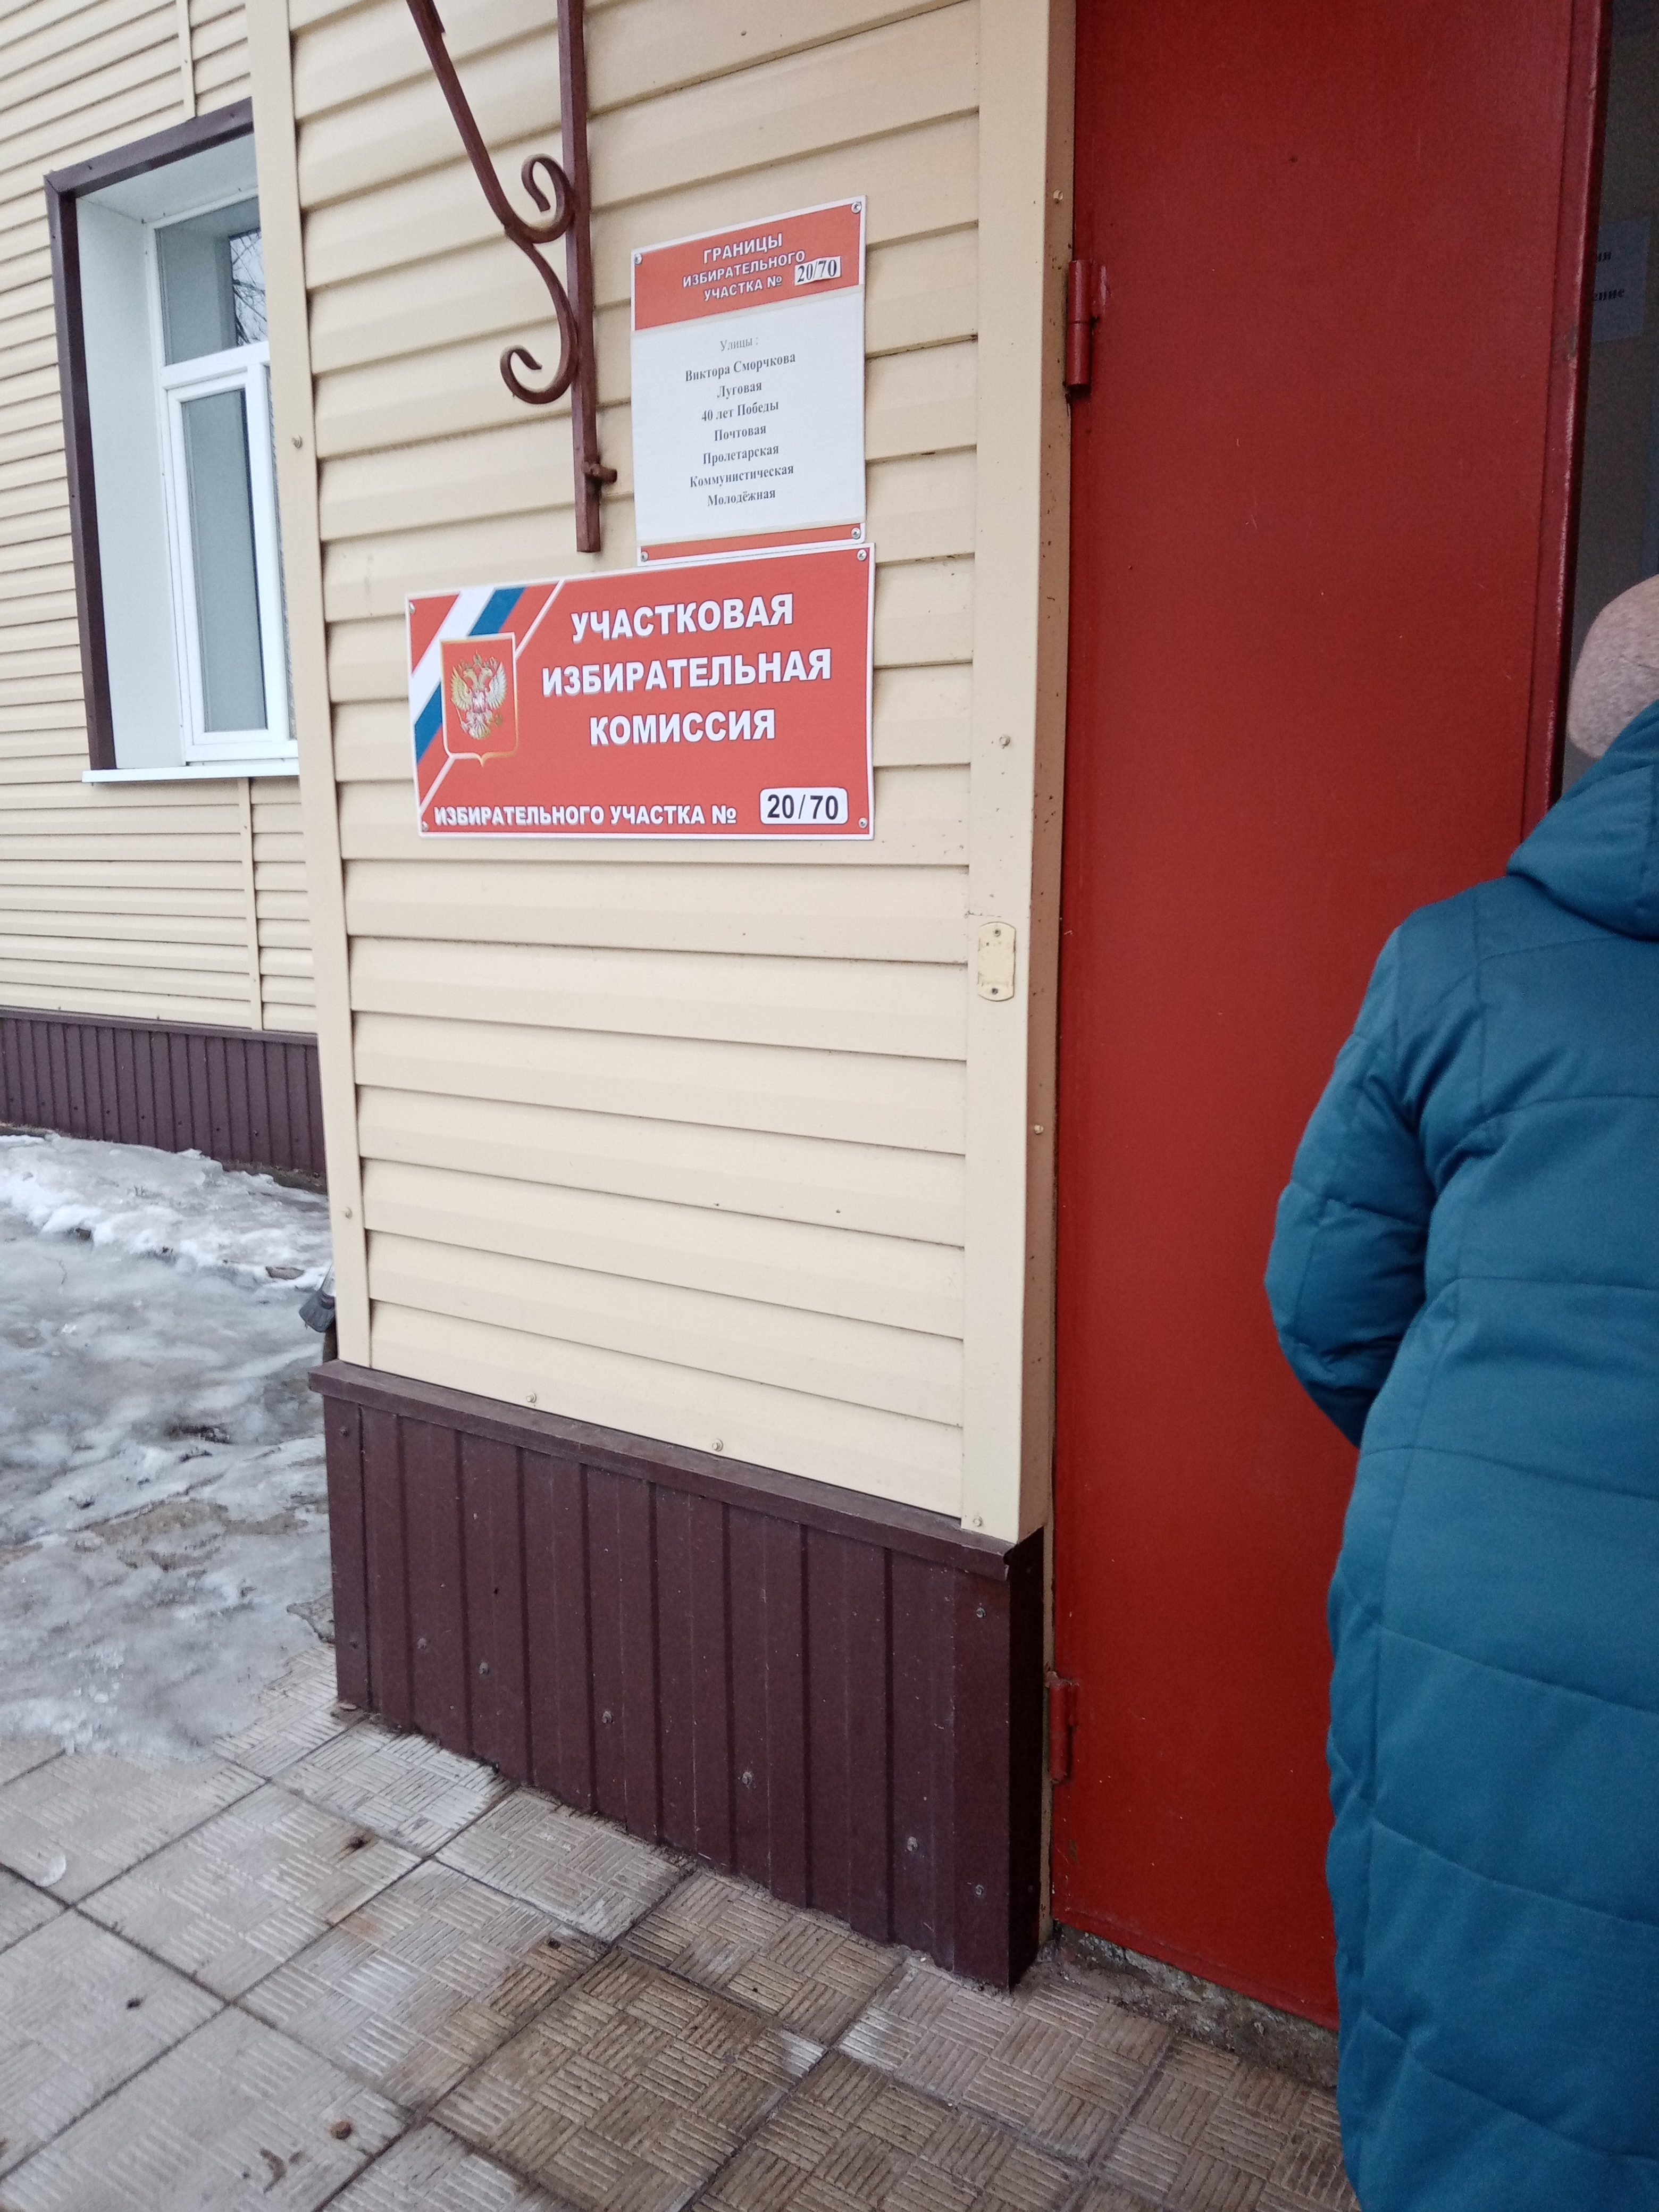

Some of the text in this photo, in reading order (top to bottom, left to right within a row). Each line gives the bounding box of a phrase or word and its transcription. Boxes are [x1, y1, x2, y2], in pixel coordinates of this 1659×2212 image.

[703, 233, 783, 264] ГРАНИЦЫ
[683, 250, 806, 288] ИЗБИРАТЕЛЬНОГО
[704, 259, 837, 301] УЧАСТКА № 20/70
[720, 338, 752, 351] Улицы
[685, 354, 795, 382] Виктора Сморчкова
[717, 382, 762, 399] Луговая
[701, 401, 779, 421] 40 лет Победы
[714, 425, 766, 441] Почтовая
[703, 446, 779, 466] Пролетарская
[690, 465, 794, 488] Коммунистическая
[707, 490, 776, 507] Молодёжная
[571, 593, 793, 644] УЧАСТКОВАЯ
[542, 648, 831, 698] ИЗБИРАТЕЛЬНАЯ
[590, 709, 775, 747] КОМИССИЯ
[434, 793, 839, 826] ИЗБИРАТЕЛЬНОГО УЧАСТКА № 20/70
